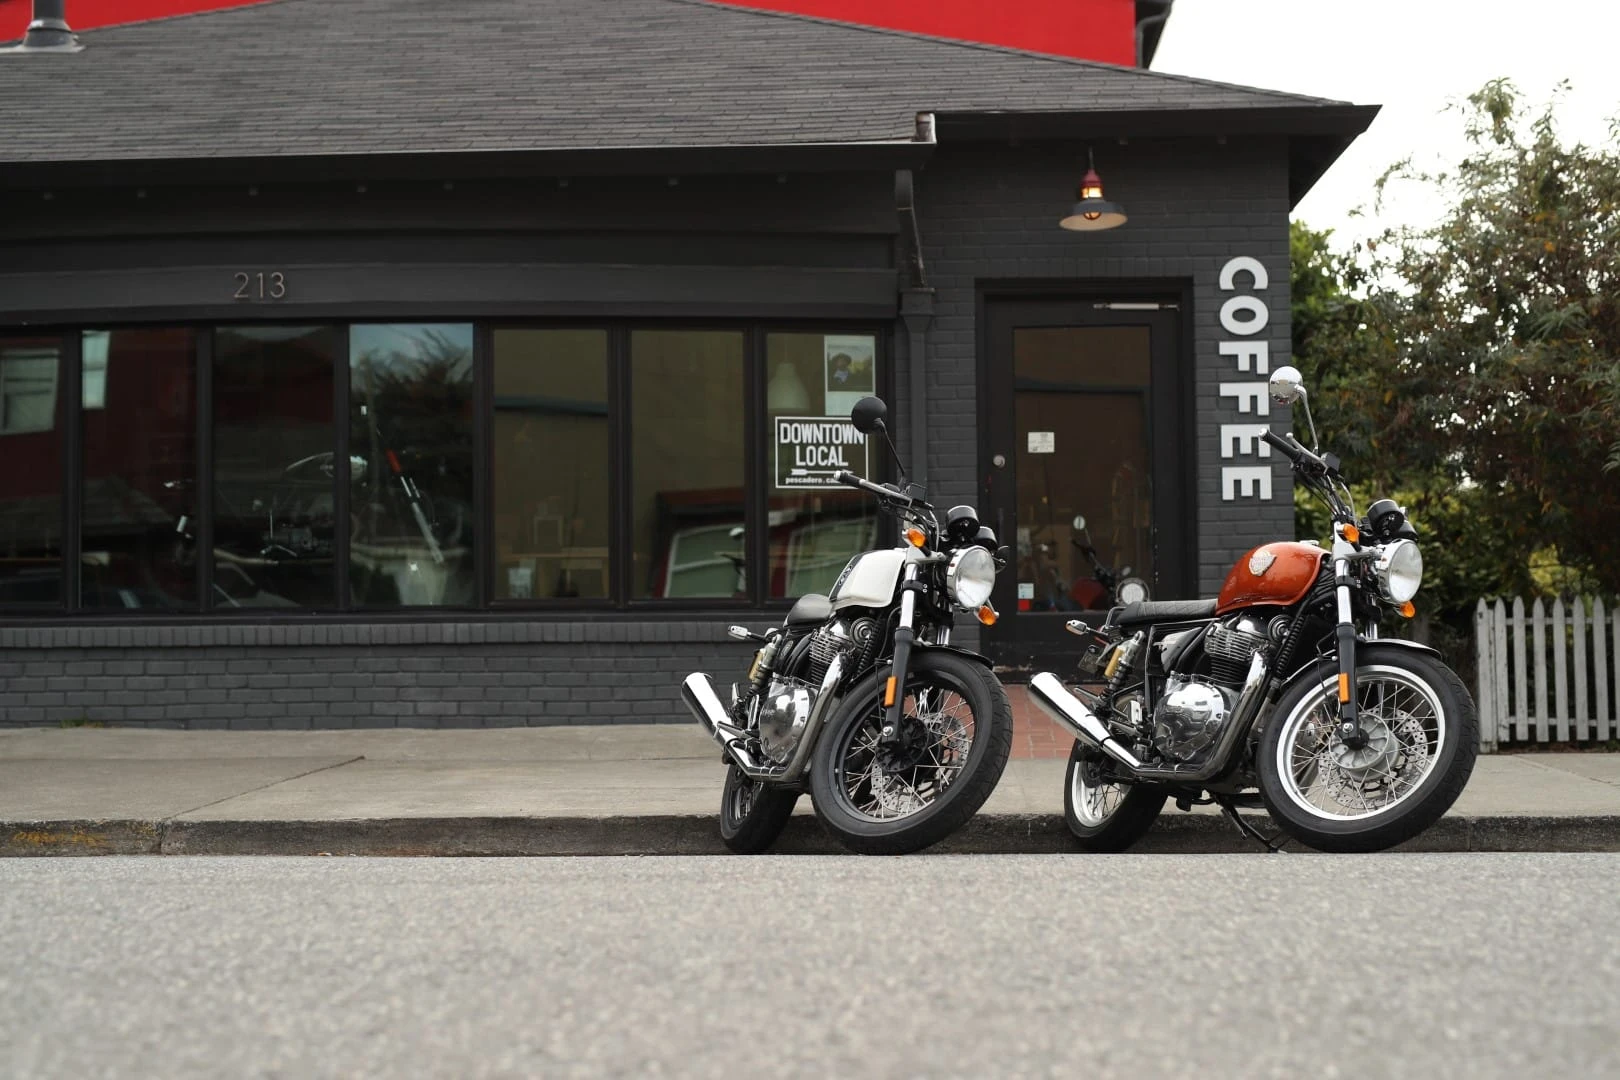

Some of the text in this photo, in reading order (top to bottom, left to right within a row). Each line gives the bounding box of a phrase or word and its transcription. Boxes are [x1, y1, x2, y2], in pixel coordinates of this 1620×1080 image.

[234, 271, 286, 299] 213
[1219, 256, 1272, 501] COFFEE
[780, 423, 865, 444] DOWNTOWN
[795, 445, 849, 466] LOCAL
